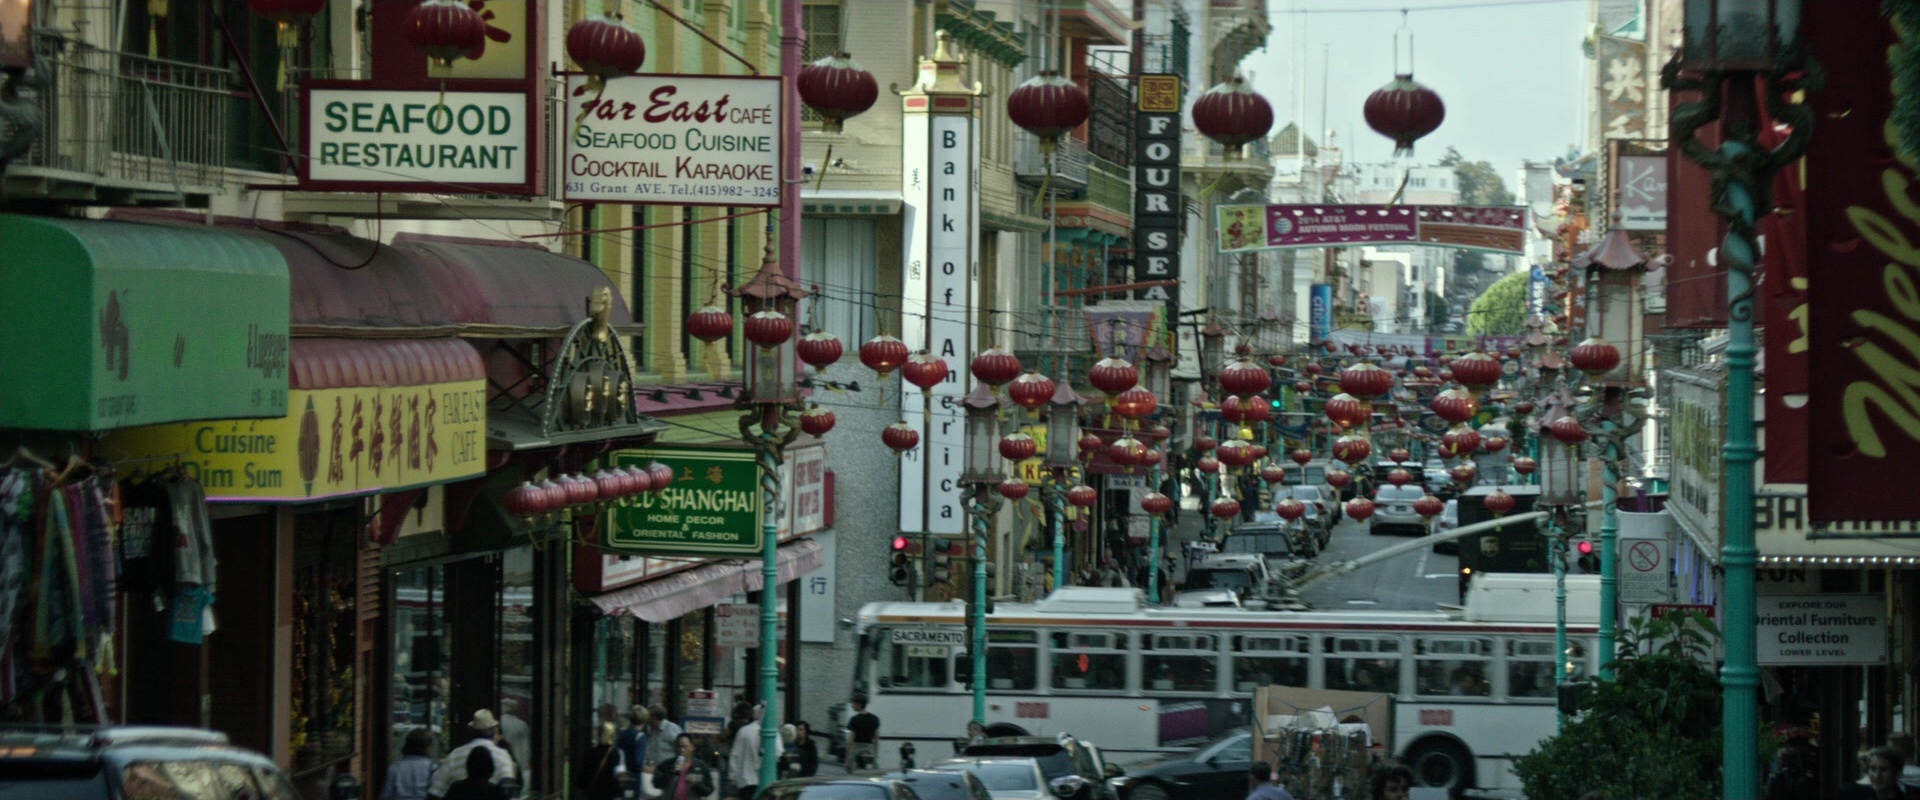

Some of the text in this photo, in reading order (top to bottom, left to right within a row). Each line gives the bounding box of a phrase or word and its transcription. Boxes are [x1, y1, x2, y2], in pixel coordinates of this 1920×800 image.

[573, 84, 773, 124] Far East CAFÉ
[325, 101, 512, 136] SEAFOOD
[576, 125, 772, 152] SEAFOOD CUISINE
[320, 142, 518, 170] RESTAURANT
[571, 153, 773, 181] COCKTAIL KARAOKE
[1145, 115, 1172, 213] FOUR
[566, 181, 585, 194] 631
[590, 182, 628, 195] Grant
[634, 183, 666, 196] AVE.
[942, 129, 957, 232] Bank
[1298, 222, 1411, 234] AUTUMN MOON FESTIVAL
[1322, 214, 1346, 223] AT&T
[1143, 231, 1171, 300] SEA
[942, 261, 956, 306] of
[1342, 343, 1414, 357] NSAN
[443, 391, 462, 424] FAR
[195, 426, 277, 455] Cuisine
[181, 460, 282, 489] Dim Sum
[660, 487, 757, 513] SHANGHAI
[647, 514, 725, 526] HOME DECOR
[681, 523, 691, 532] &
[632, 528, 739, 541] ORIENTAL FASHION
[810, 576, 827, 595] 行
[1779, 601, 1847, 610] EXPLORE OUR
[1810, 613, 1877, 626] Furniture
[893, 630, 964, 643] SACRAMENTO
[1778, 631, 1849, 644] Collection
[1780, 649, 1847, 657] LOWER LEVEL
